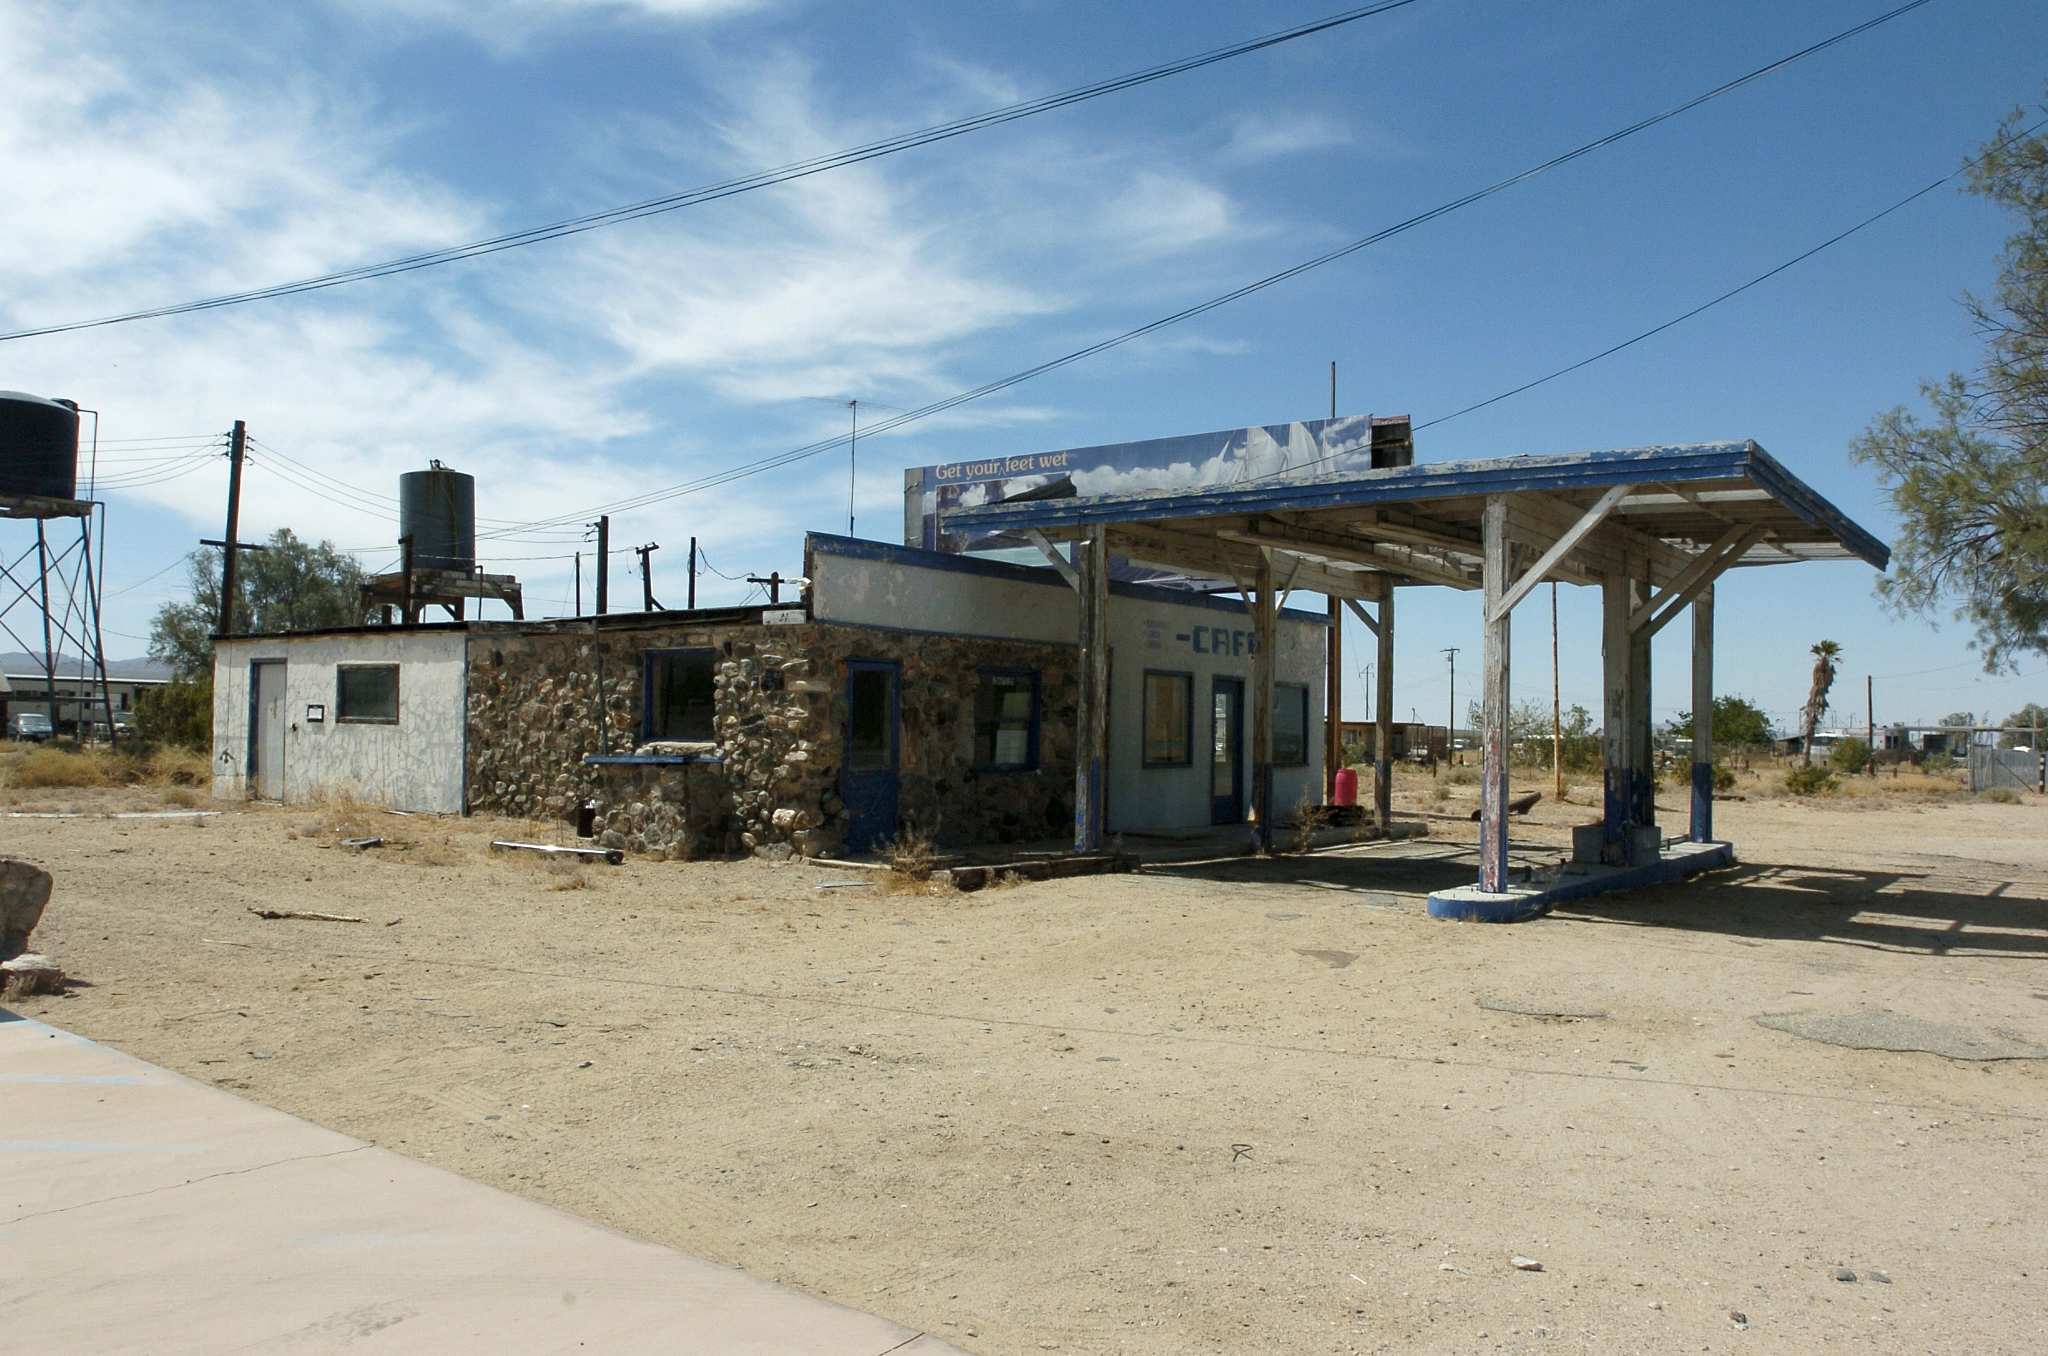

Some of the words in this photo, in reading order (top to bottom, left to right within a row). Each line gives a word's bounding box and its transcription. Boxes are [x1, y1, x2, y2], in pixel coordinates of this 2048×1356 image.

[935, 464, 962, 480] Get
[966, 461, 1001, 480] your
[1005, 456, 1035, 472] feet
[1039, 452, 1068, 468] wet
